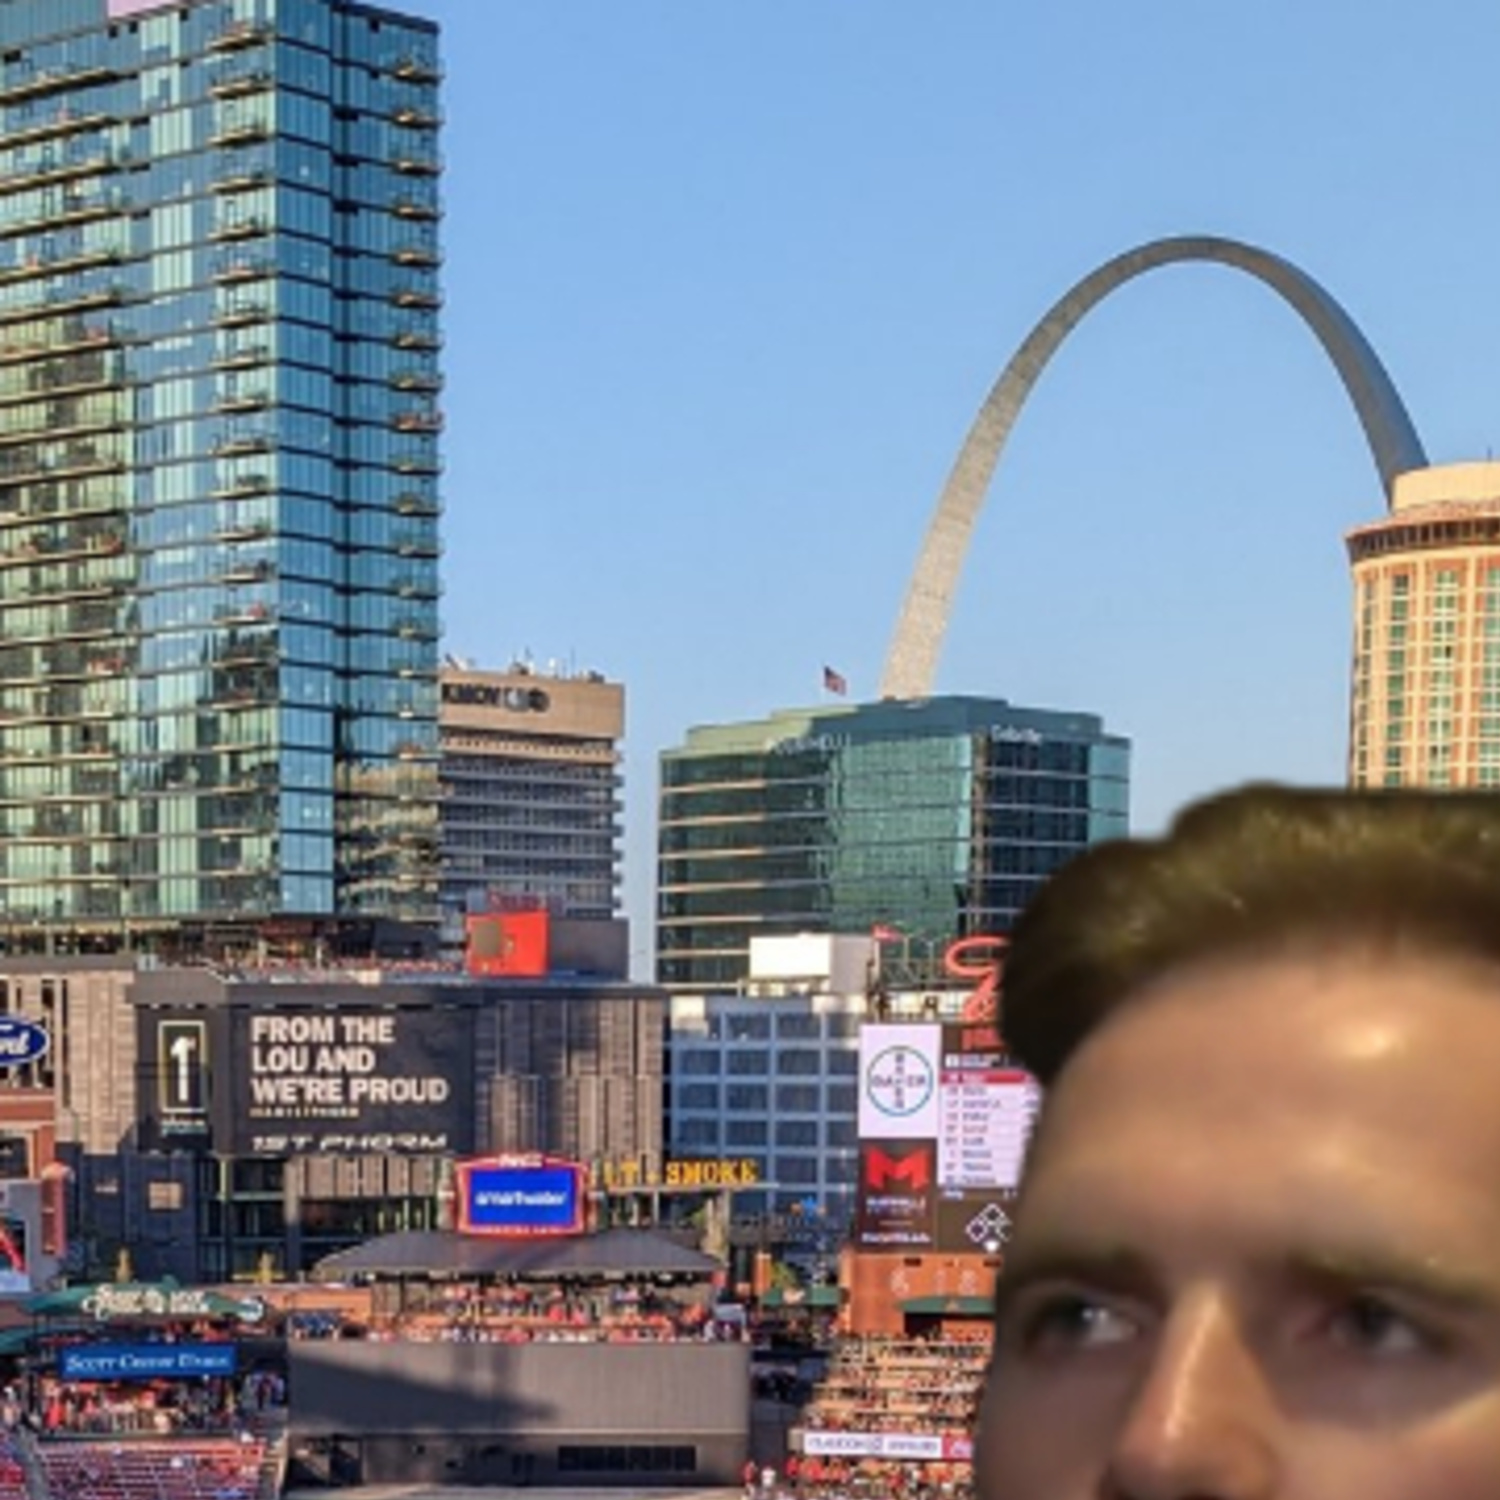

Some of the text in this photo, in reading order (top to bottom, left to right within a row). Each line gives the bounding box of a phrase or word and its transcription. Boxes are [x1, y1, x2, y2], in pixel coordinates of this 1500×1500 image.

[252, 1016, 396, 1042] FROM THE
[253, 1047, 377, 1072] LOU AND
[251, 1078, 451, 1102] WE'RE PROUD
[665, 1160, 757, 1185] SMOKE
